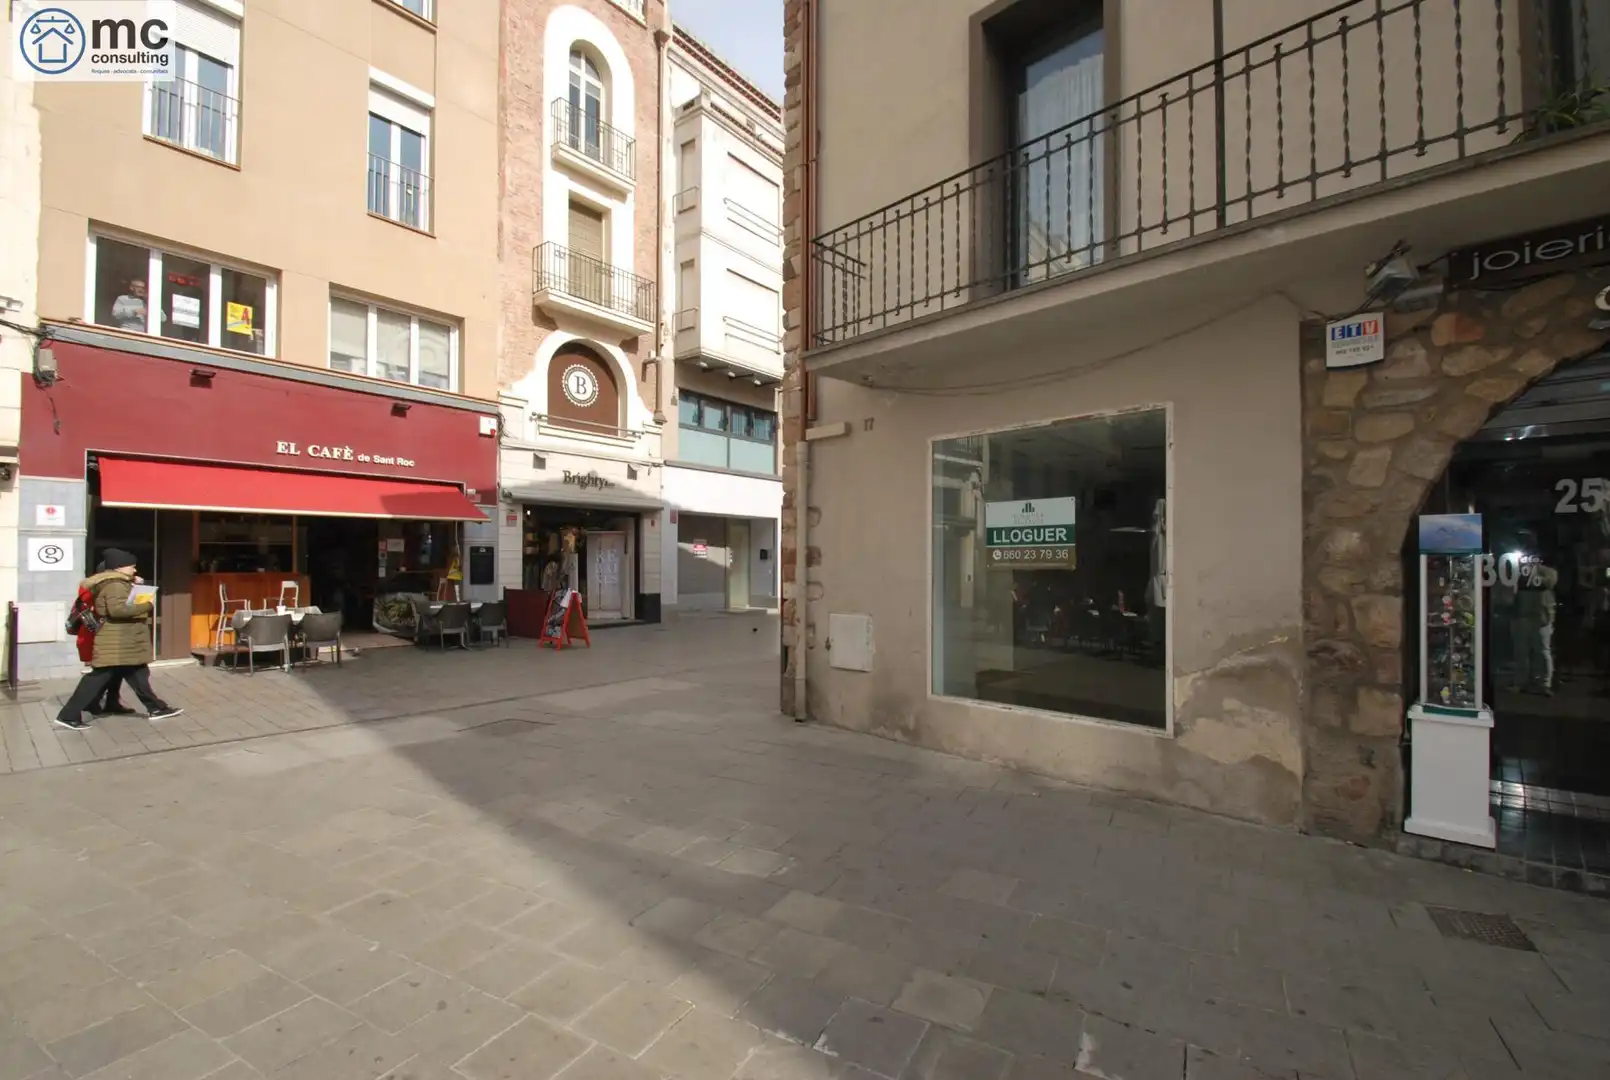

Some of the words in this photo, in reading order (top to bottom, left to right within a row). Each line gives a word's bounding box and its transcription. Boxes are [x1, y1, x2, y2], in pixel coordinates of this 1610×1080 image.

[1470, 225, 1610, 280] joieri
[1331, 320, 1379, 341] ETV
[574, 374, 587, 395] B
[863, 416, 875, 431] 17
[276, 440, 301, 456] EL
[307, 444, 354, 461] CAFÈ
[357, 454, 371, 463] de
[373, 454, 394, 465] Sant
[396, 456, 415, 467] Roc
[562, 469, 605, 491] Brighty
[993, 528, 1067, 544] LLOGUER
[1023, 549, 1036, 559] 23
[1039, 549, 1053, 559] 79
[1055, 549, 1069, 559] 36
